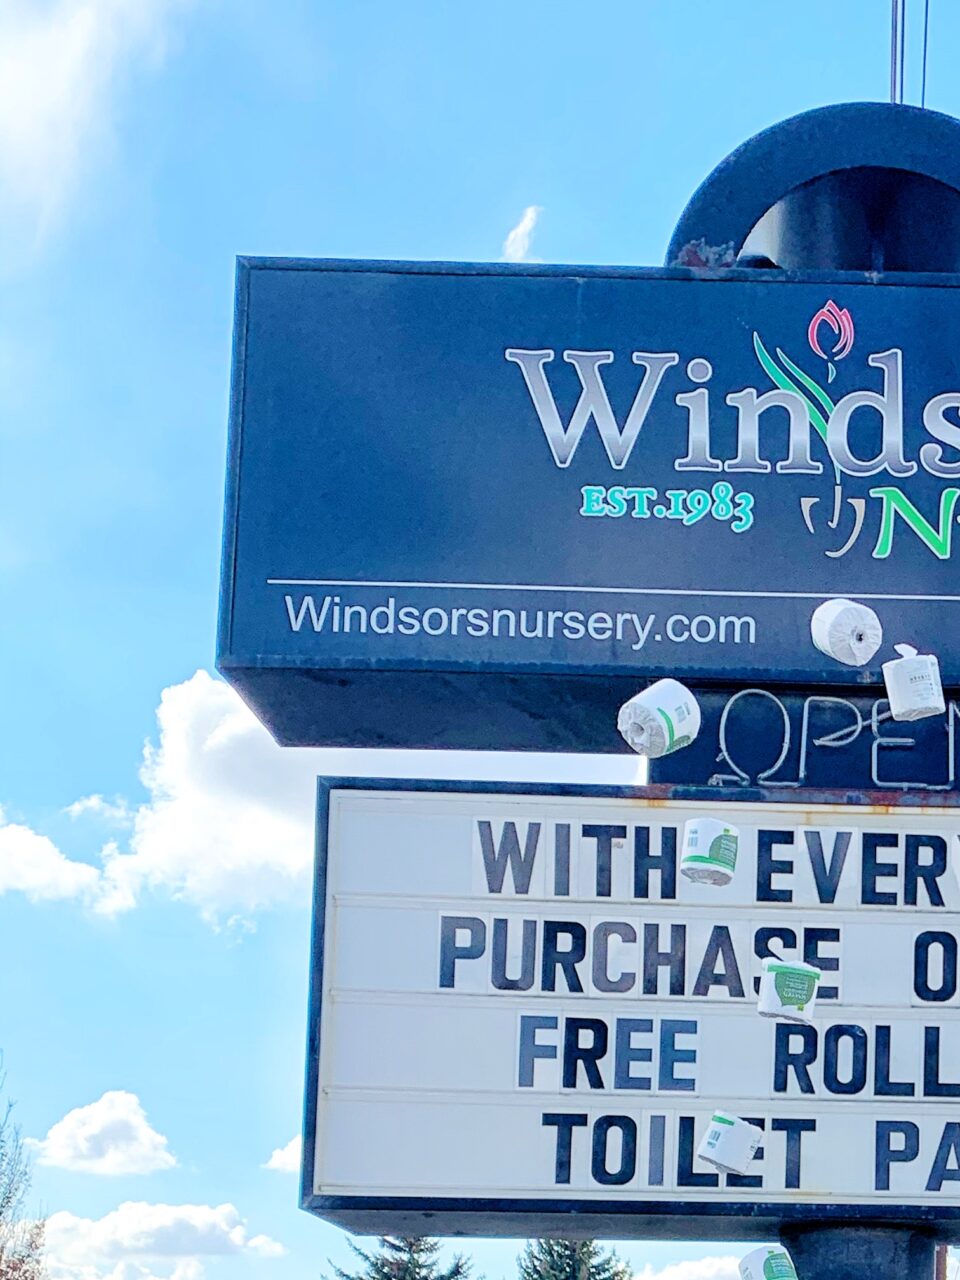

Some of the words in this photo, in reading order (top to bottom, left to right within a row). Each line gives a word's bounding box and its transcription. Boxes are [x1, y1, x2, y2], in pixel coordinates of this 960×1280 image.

[580, 481, 755, 533] EST.1983
[285, 595, 757, 650] Windsorsnursery.com
[477, 820, 678, 899] WITH
[439, 916, 841, 999] PURCHASE
[518, 1015, 698, 1092] FREE
